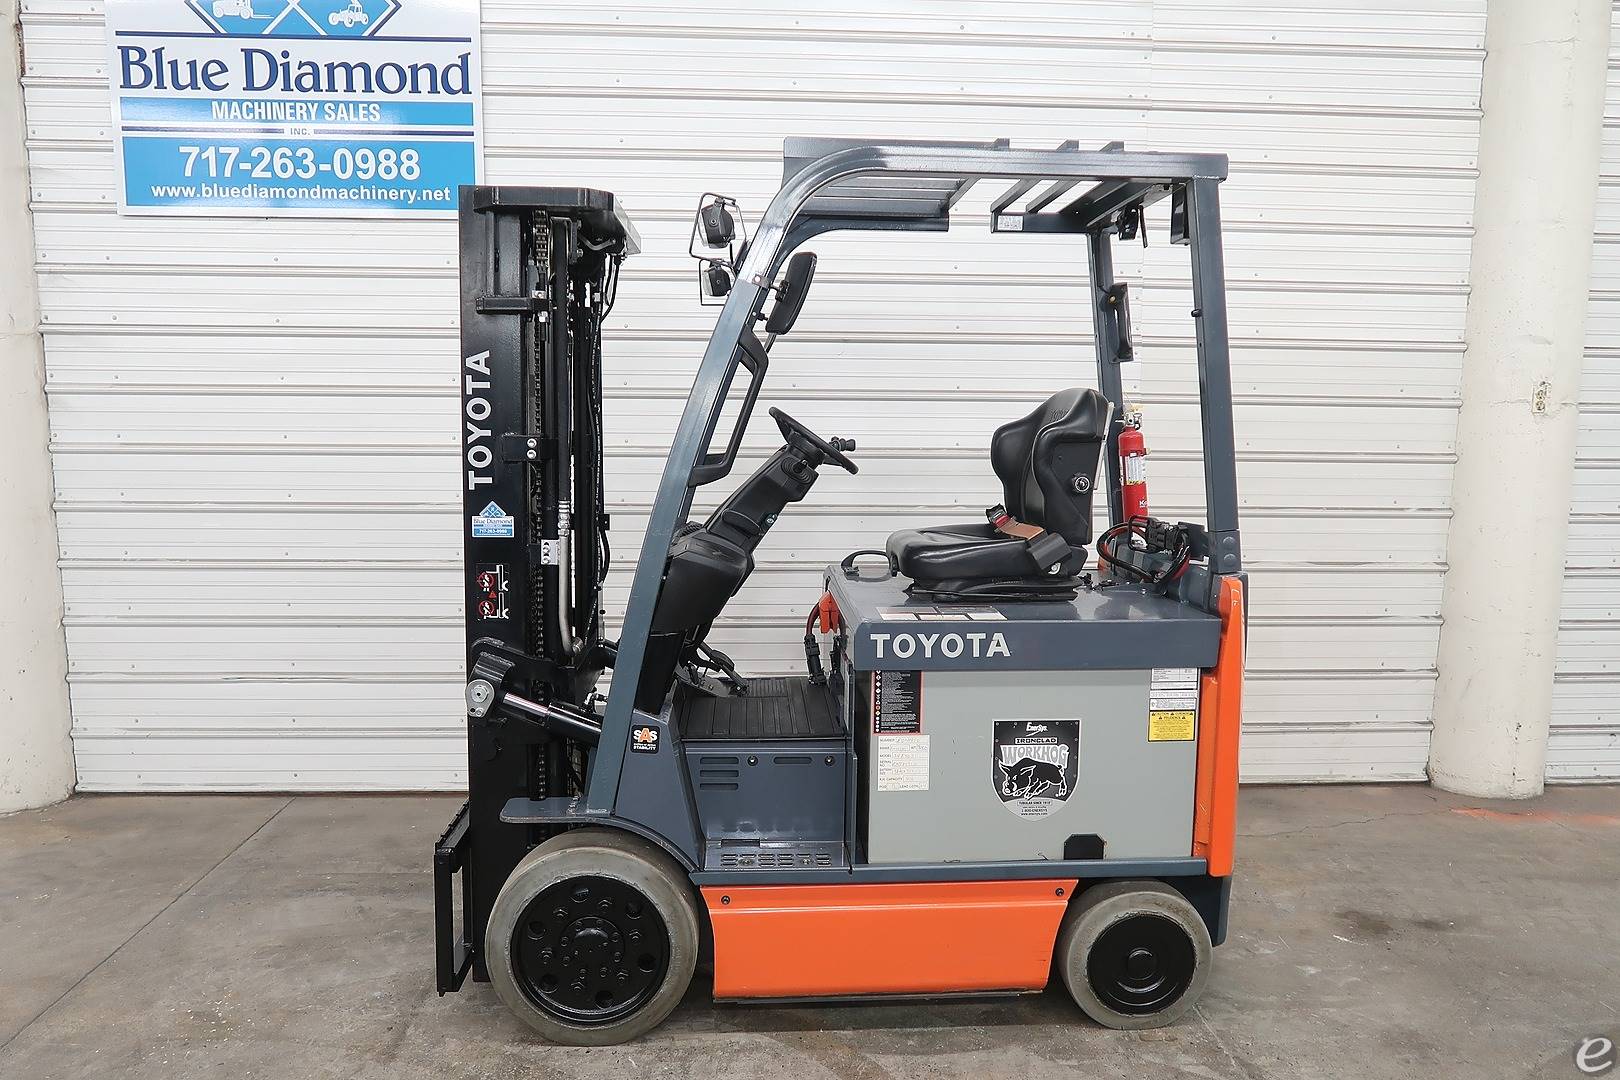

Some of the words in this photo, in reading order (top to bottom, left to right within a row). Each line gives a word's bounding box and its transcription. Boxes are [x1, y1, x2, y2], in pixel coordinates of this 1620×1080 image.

[117, 45, 229, 91] Blue
[240, 47, 472, 95] Diamond
[211, 101, 318, 121] MACHINERY
[324, 103, 381, 122] SALES
[289, 127, 311, 136] INC.
[178, 146, 421, 181] 717-263-0988
[150, 183, 451, 204] www.bluediamondmachinery.net
[465, 350, 493, 491] TOYOTA
[870, 632, 1011, 659] TOYOTA
[633, 727, 658, 743] SAS
[1000, 744, 1069, 768] WORKHOG
